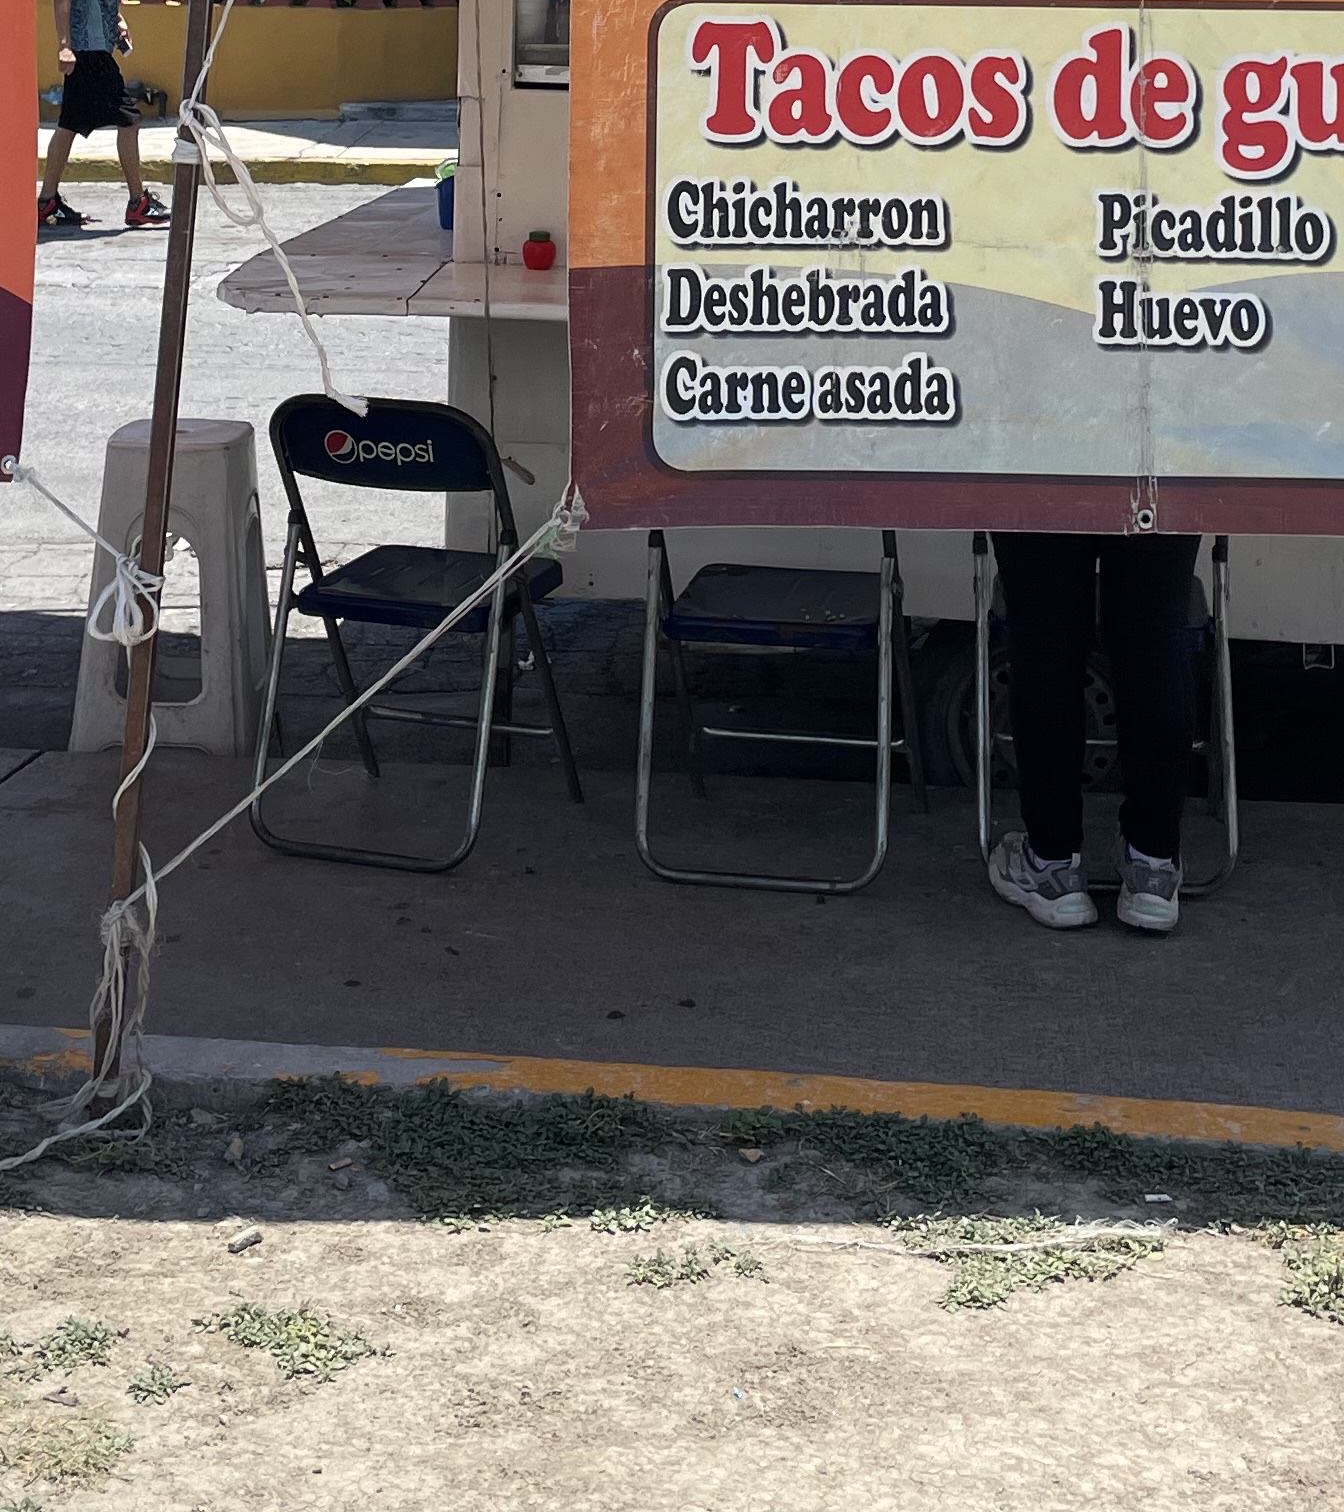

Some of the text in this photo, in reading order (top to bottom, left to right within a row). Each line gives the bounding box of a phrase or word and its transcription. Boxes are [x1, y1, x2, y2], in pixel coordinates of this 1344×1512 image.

[689, 18, 1022, 141] Tacos
[1051, 26, 1191, 143] de
[665, 178, 942, 240] Chicharron
[1096, 192, 1326, 256] Picadillo
[664, 266, 945, 328] Deshebrada
[1096, 280, 1258, 344] Huevo
[664, 355, 952, 416] Carne asada
[358, 439, 435, 466] pepsi
